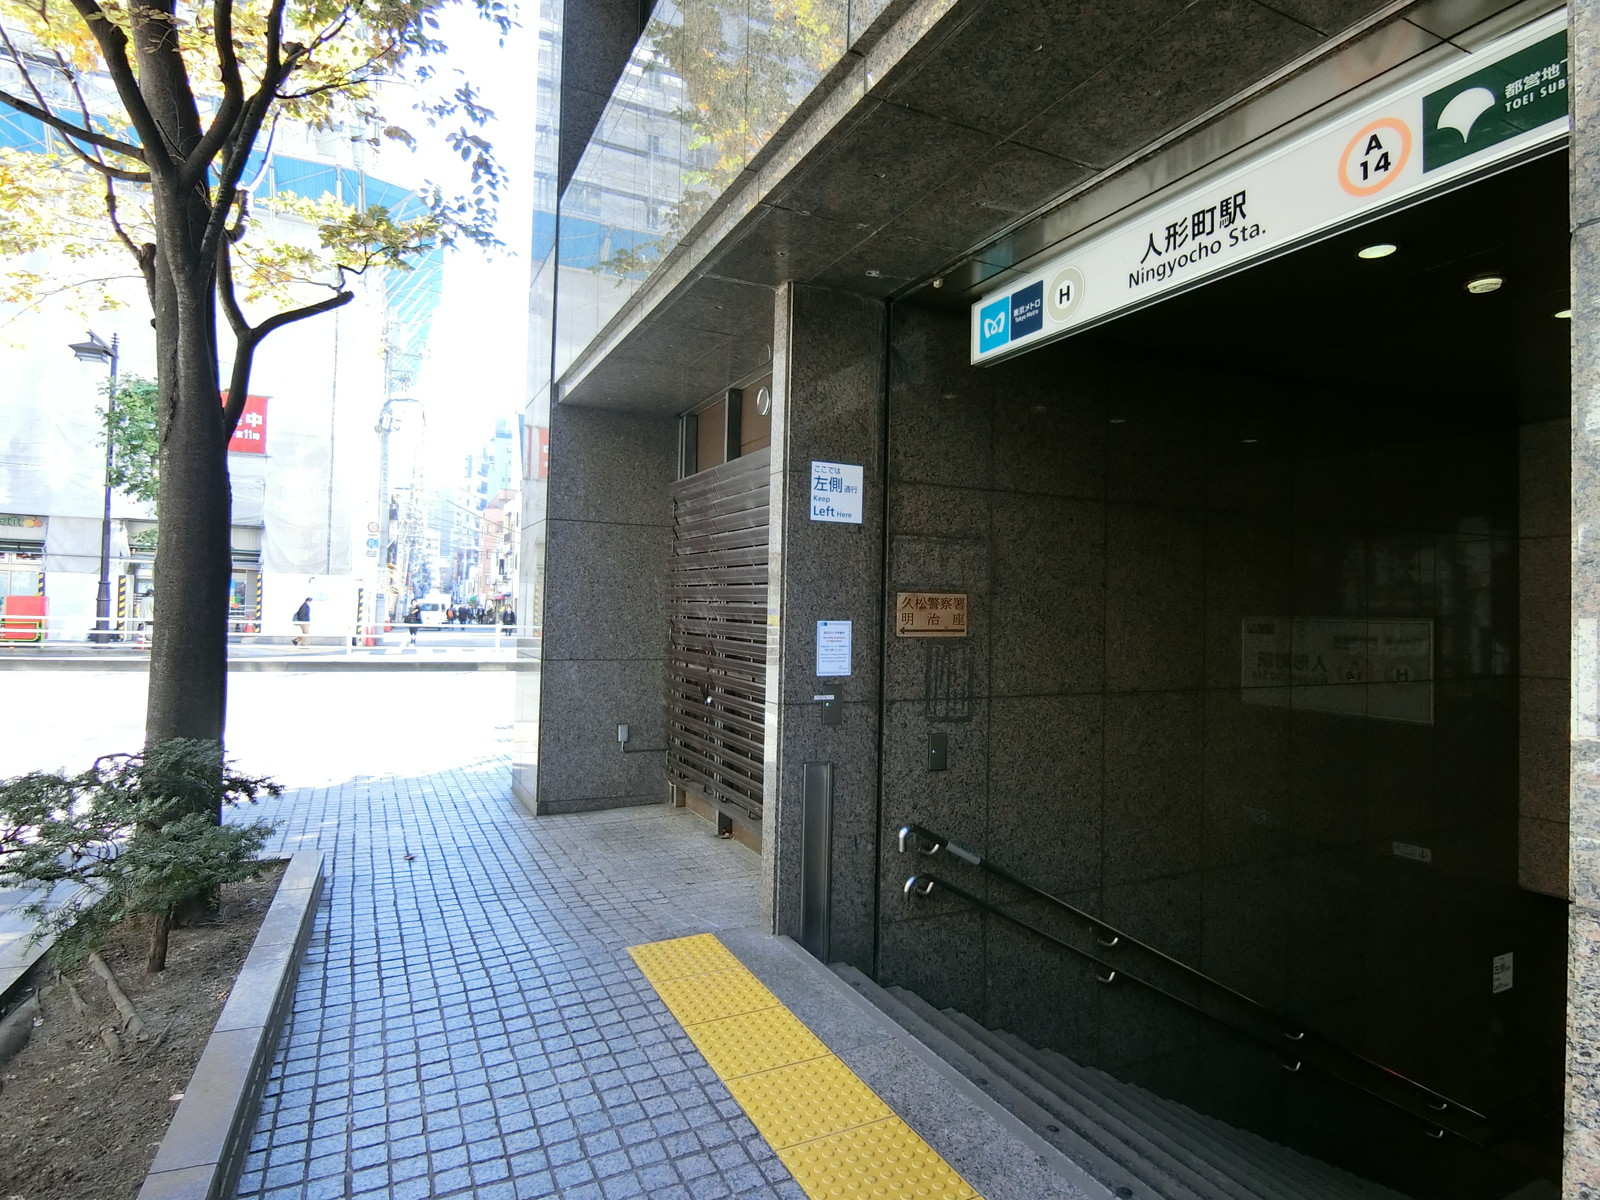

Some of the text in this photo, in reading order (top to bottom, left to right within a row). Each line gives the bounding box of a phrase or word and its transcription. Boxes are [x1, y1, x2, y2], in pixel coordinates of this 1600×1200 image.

[1505, 58, 1568, 99] 都営地
[1505, 77, 1567, 112] TOEI SUB
[1364, 133, 1383, 154] A
[1358, 154, 1392, 182] 14
[1139, 189, 1247, 265] 人形町駅
[1128, 223, 1267, 289] Ningyocho Sta.
[1059, 285, 1070, 305] H
[1013, 299, 1041, 317] 東京メトロ
[1015, 309, 1039, 323] Tokyo Metro
[814, 465, 841, 475] ここでは
[813, 495, 831, 503] Keep
[813, 505, 835, 517] Left
[901, 596, 965, 610] 久松警察署
